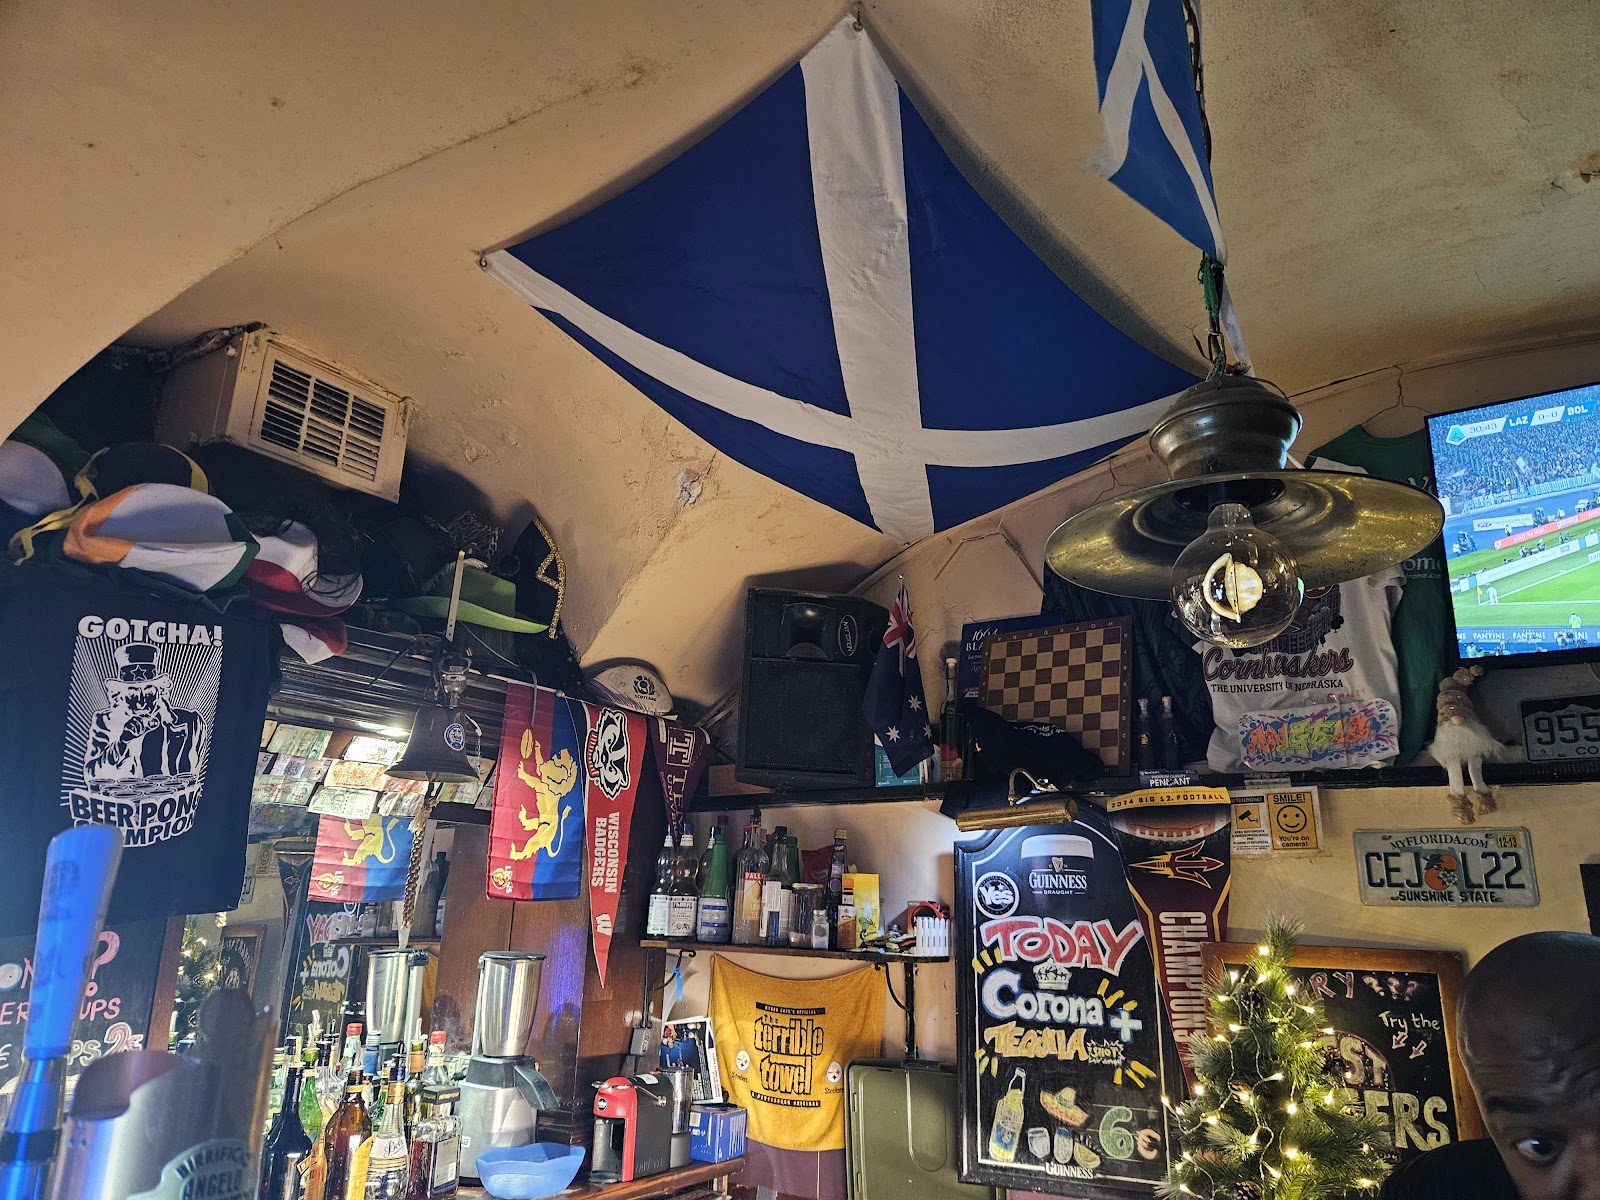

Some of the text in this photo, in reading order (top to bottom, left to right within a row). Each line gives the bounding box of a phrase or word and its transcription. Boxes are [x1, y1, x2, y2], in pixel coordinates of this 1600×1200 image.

[1509, 416, 1528, 427] LAZ
[1567, 405, 1589, 416] BOL
[77, 615, 224, 648] GOTCHA!
[1203, 645, 1354, 682] Cornhuskers
[1211, 683, 1229, 693] THE
[1230, 682, 1283, 693] UNIVERSITY
[1294, 679, 1343, 692] NEBRASKA
[70, 792, 134, 827] BEER
[1111, 799, 1134, 808] 2024
[1176, 793, 1224, 801] FOOTBALL
[1273, 794, 1306, 803] SMILE!
[590, 817, 607, 888] BADGERS
[604, 812, 620, 893] WISCONSIN
[1390, 834, 1489, 851] MYFLORIDA.COM
[1498, 836, 1519, 848] 12-13
[1028, 871, 1087, 890] GUINNESS
[1364, 851, 1525, 889] CEJ L22
[979, 886, 1014, 905] Yes
[1397, 890, 1497, 902] SUNSHINE STATE
[980, 916, 1144, 976] TODAY
[1159, 911, 1208, 1044] CHAMPIONS
[79, 997, 121, 1021] UPS
[982, 967, 1104, 1027] Corona
[1379, 1011, 1441, 1033] Try the
[754, 1017, 824, 1056] terrible
[760, 1054, 813, 1095] towel
[825, 1087, 844, 1095] Steeler
[1363, 1090, 1451, 1152] ERS
[1044, 1161, 1094, 1179] GUINNESS
